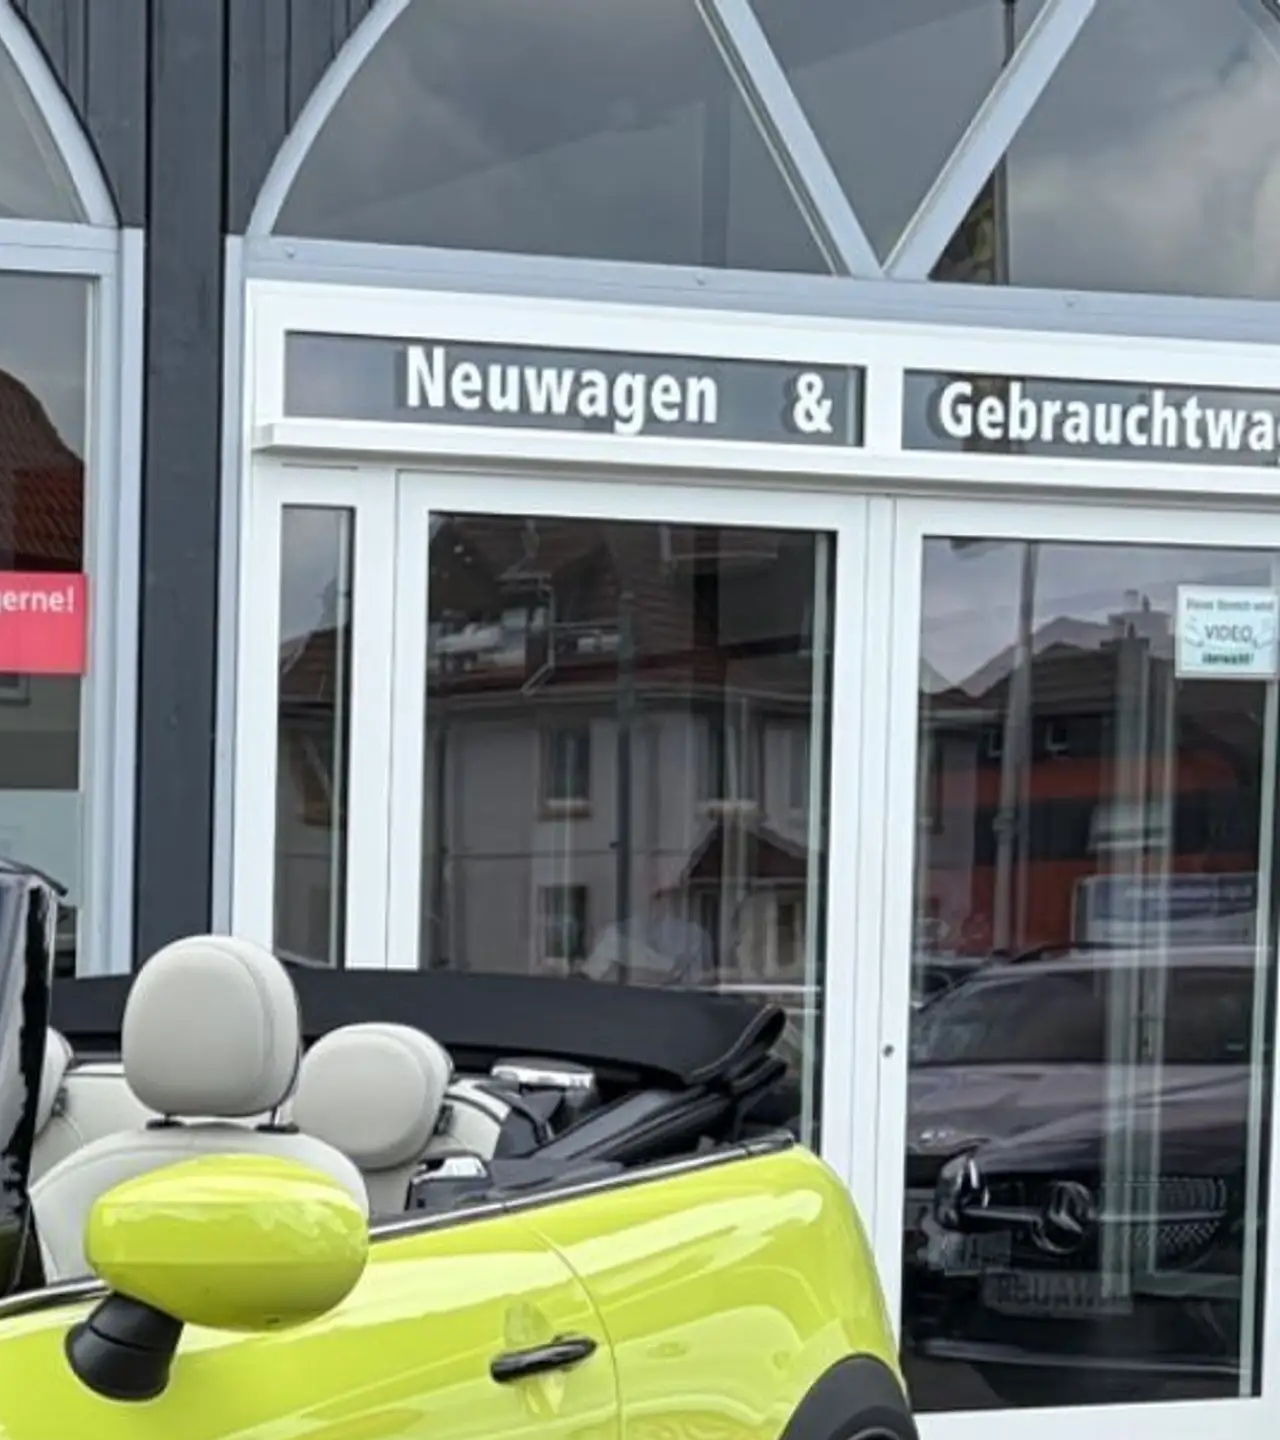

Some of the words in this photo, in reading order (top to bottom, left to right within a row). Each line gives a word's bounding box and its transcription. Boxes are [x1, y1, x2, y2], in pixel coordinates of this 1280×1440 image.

[406, 346, 718, 435] Neuwagen
[793, 373, 833, 434] &
[940, 381, 1280, 463] Gebrauchtwa
